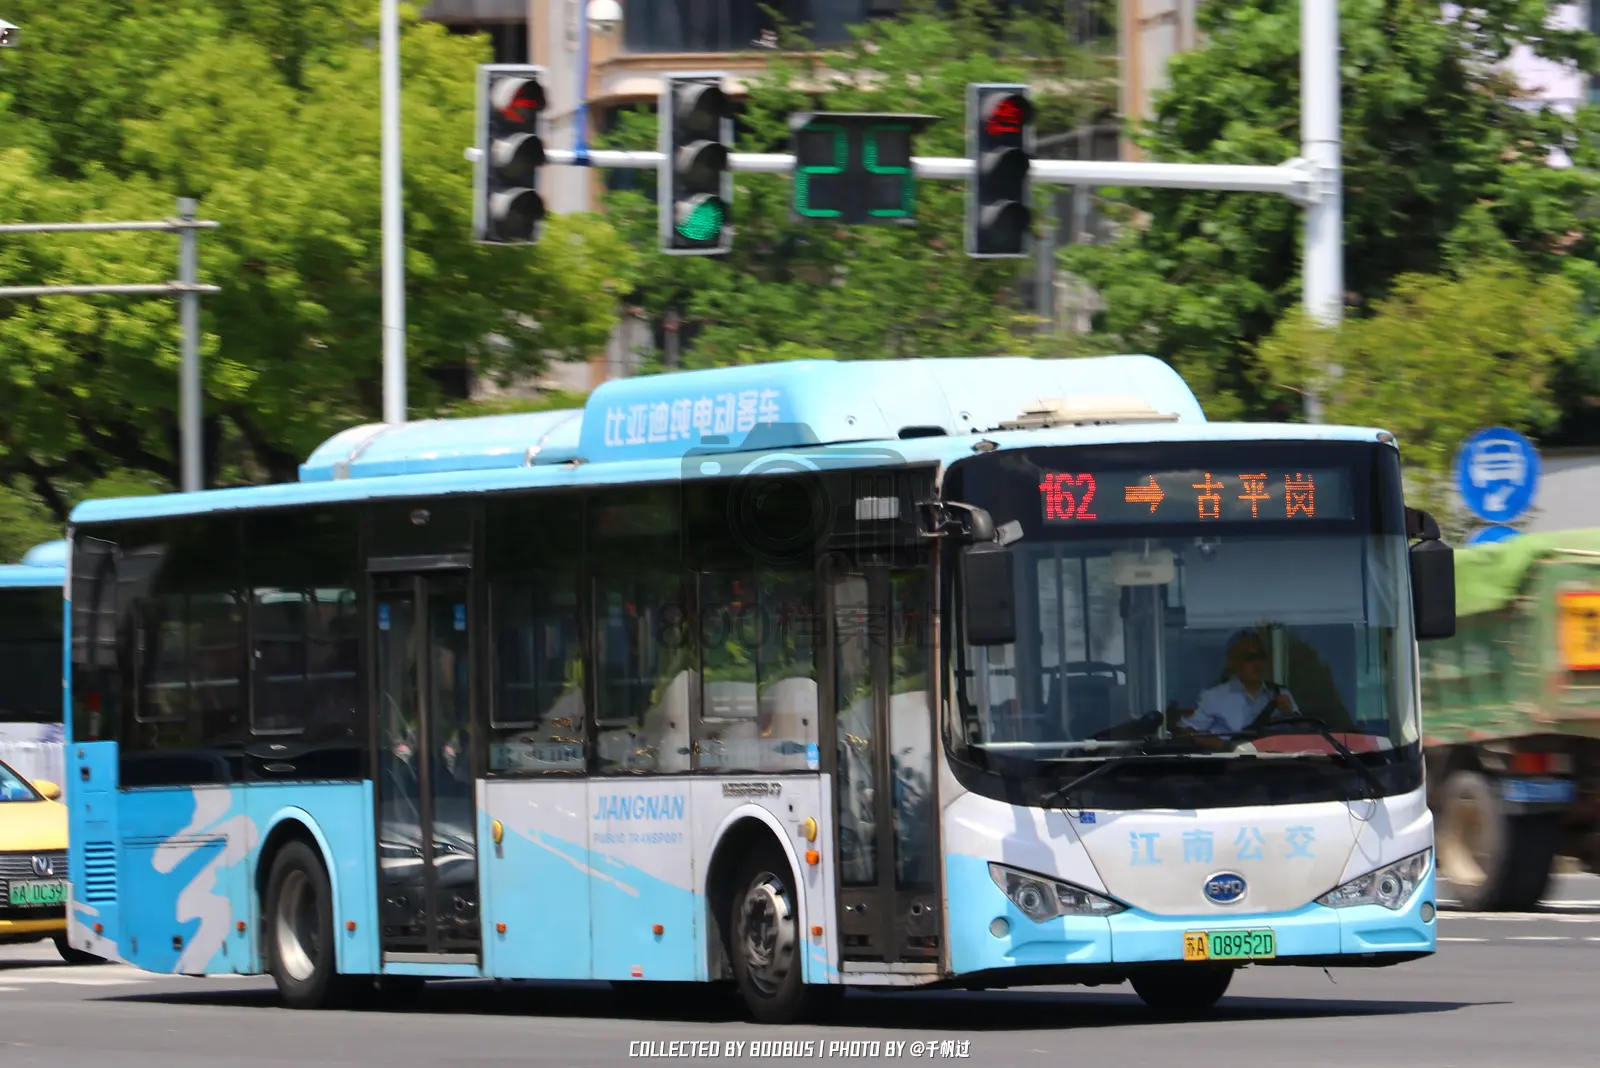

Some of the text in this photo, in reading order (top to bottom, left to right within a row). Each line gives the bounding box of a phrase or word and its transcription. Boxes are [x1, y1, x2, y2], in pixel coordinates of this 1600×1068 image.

[795, 125, 915, 216] 25
[605, 387, 780, 447] 比亚迪纯电动客车
[1039, 472, 1316, 519] 162 古平岗
[594, 795, 685, 820] JIANGNAN
[593, 832, 684, 844] PUBLIC TRANSPORT
[1128, 825, 1317, 866] 江南公交
[1209, 880, 1242, 896] BYD
[1213, 934, 1273, 956] 08952D
